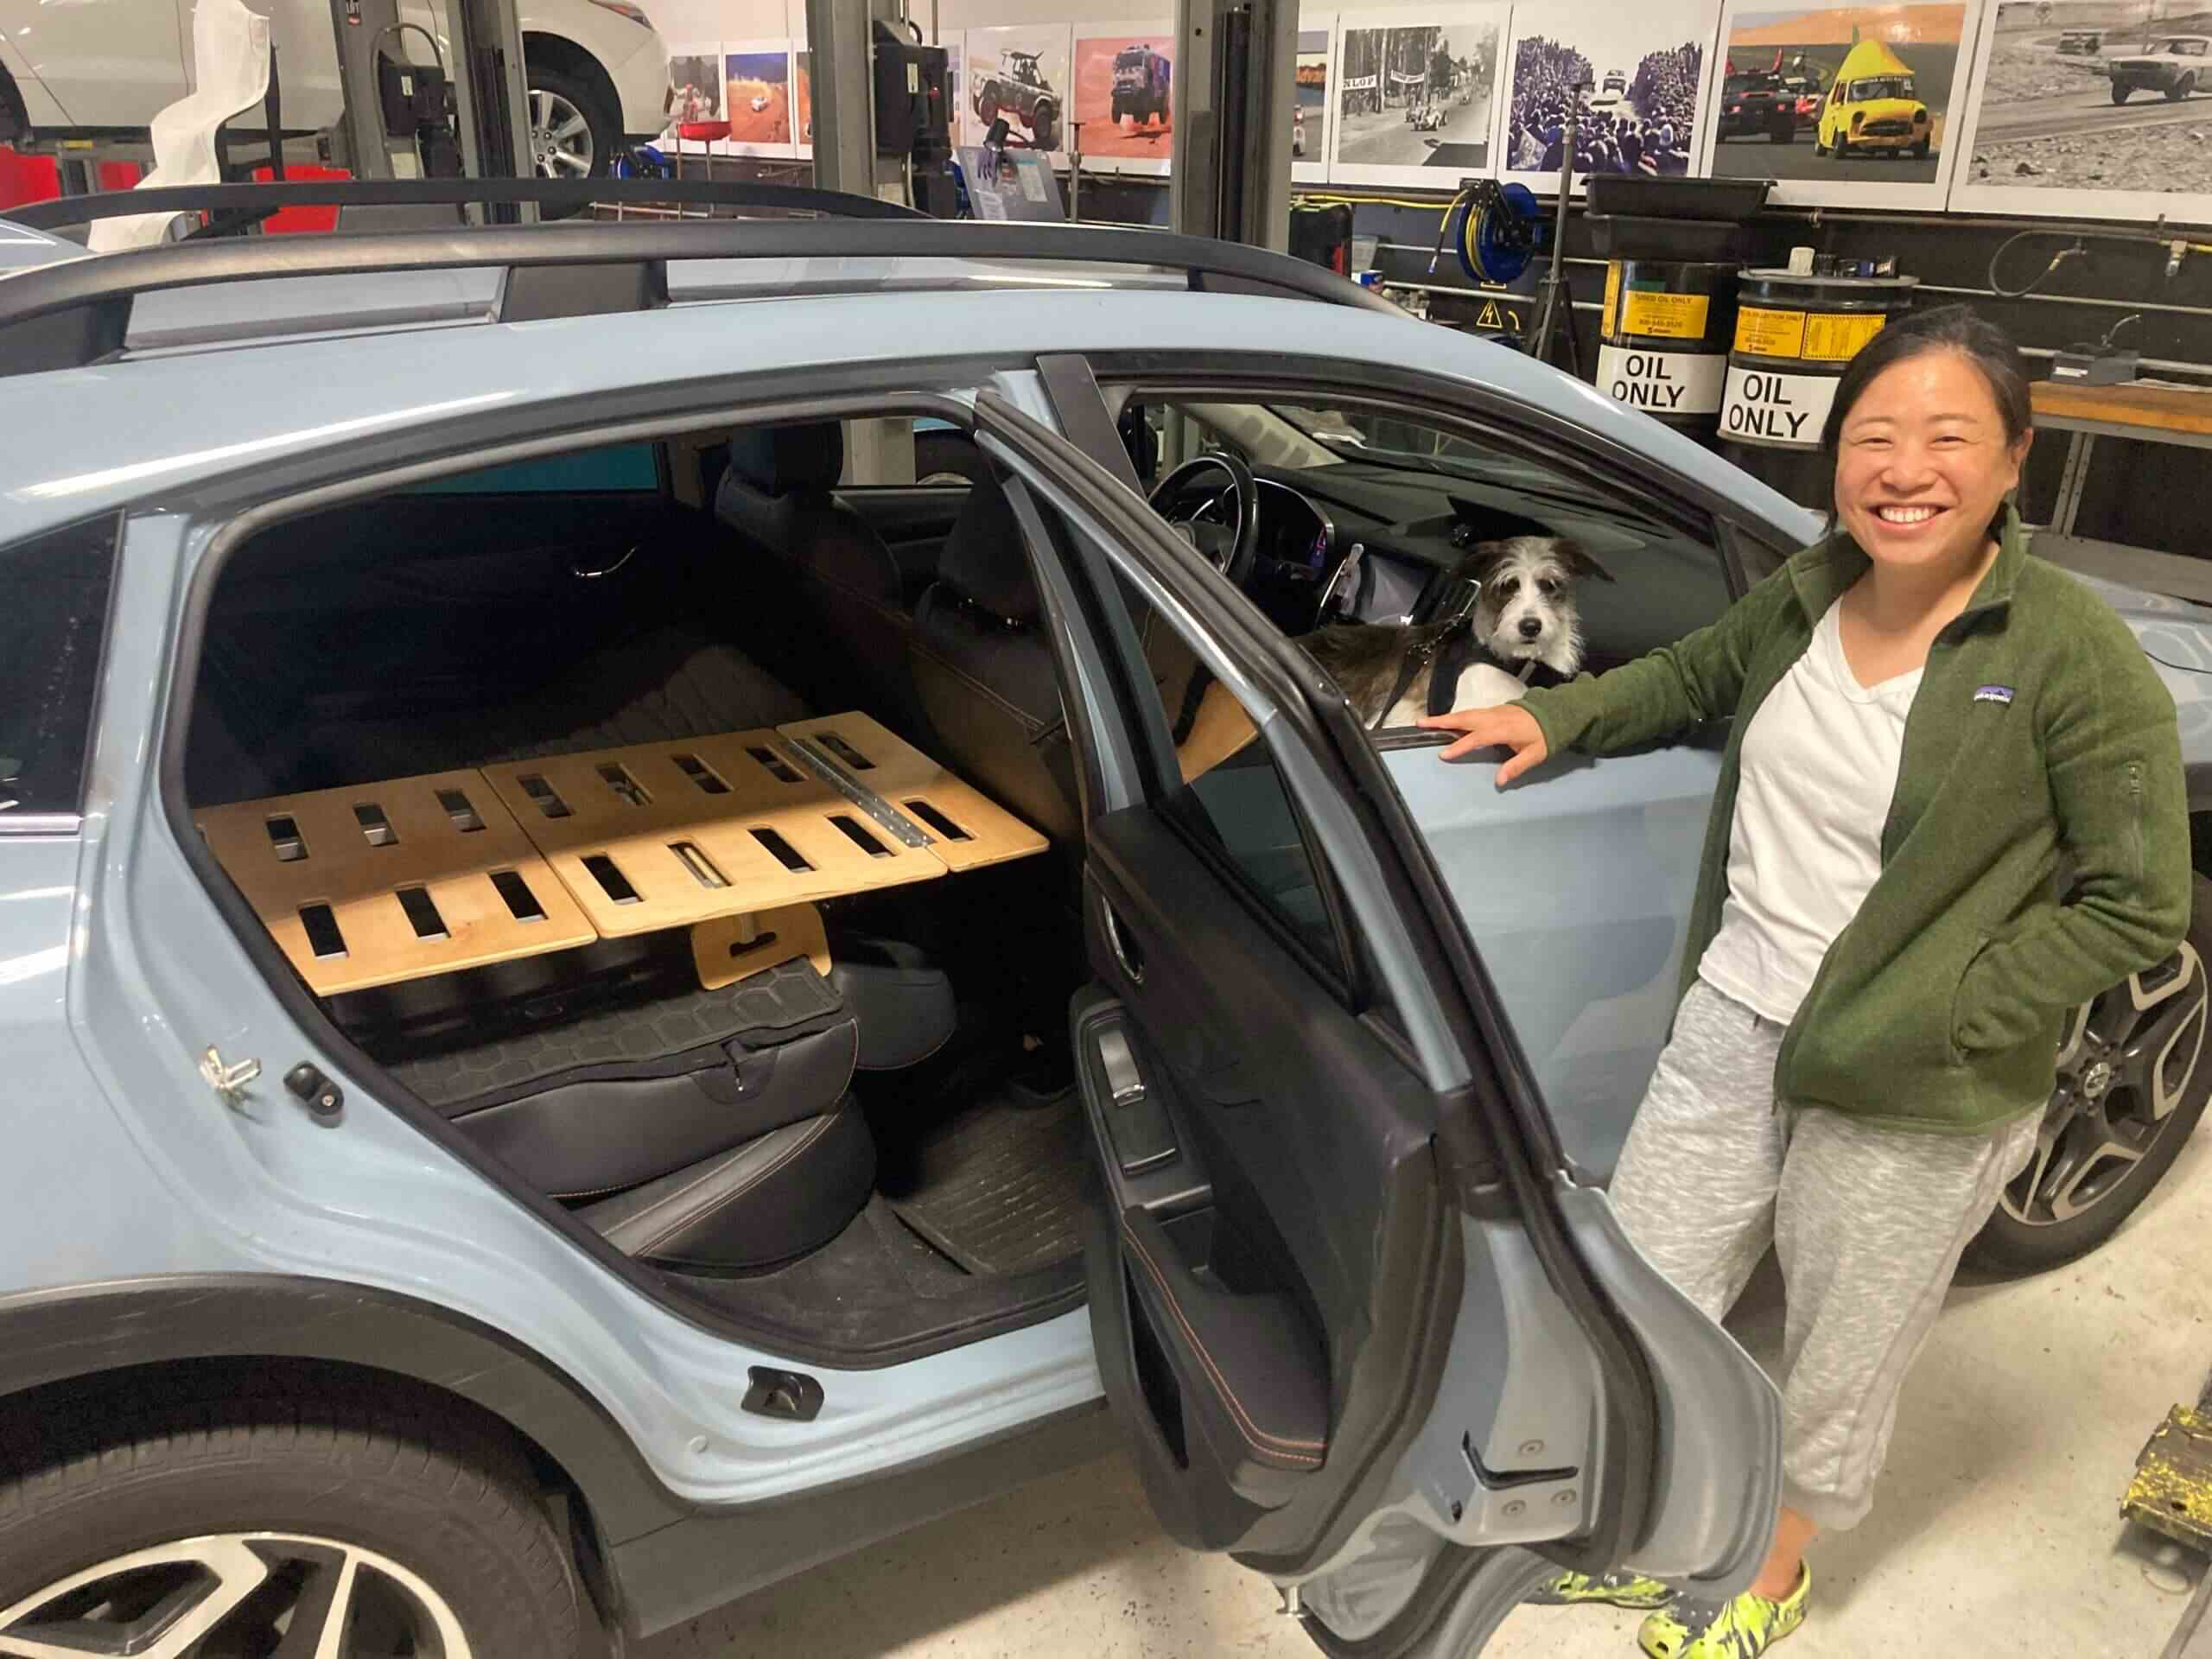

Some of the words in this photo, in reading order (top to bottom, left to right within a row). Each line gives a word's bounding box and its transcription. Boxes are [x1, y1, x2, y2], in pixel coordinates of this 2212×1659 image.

[1625, 354, 1671, 379] OIL
[1611, 380, 1685, 408] ONLY
[1743, 374, 1792, 405] OIL
[1729, 404, 1809, 438] ONLY
